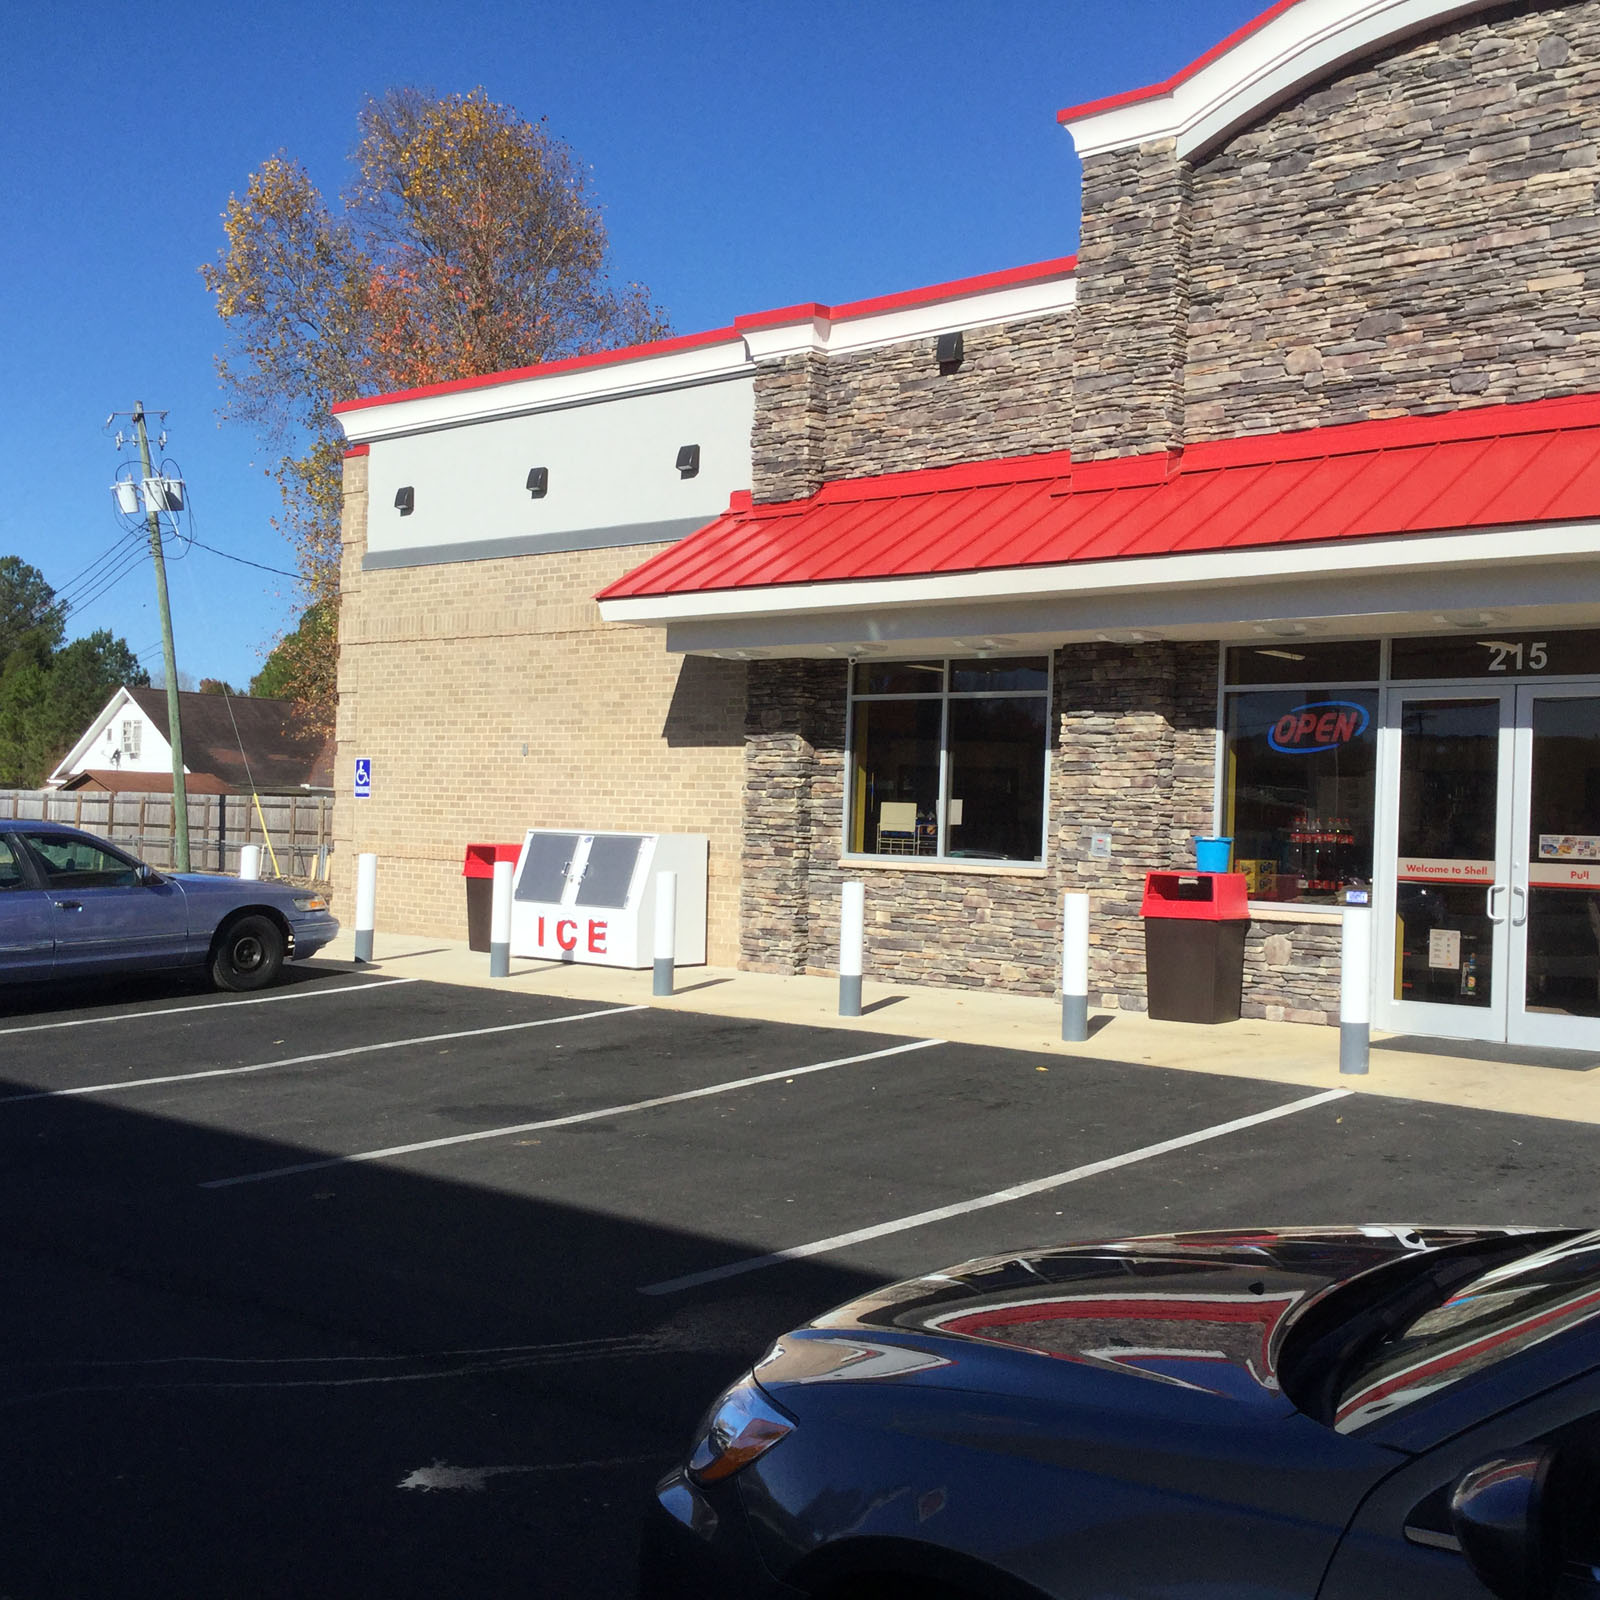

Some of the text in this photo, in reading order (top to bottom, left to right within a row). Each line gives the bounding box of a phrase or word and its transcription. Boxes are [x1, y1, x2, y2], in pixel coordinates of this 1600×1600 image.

[1488, 642, 1548, 671] 215
[1274, 711, 1358, 744] OPEN
[1406, 864, 1488, 876] Welcome to Shell
[1570, 870, 1590, 880] Pull
[538, 915, 608, 954] ICE
